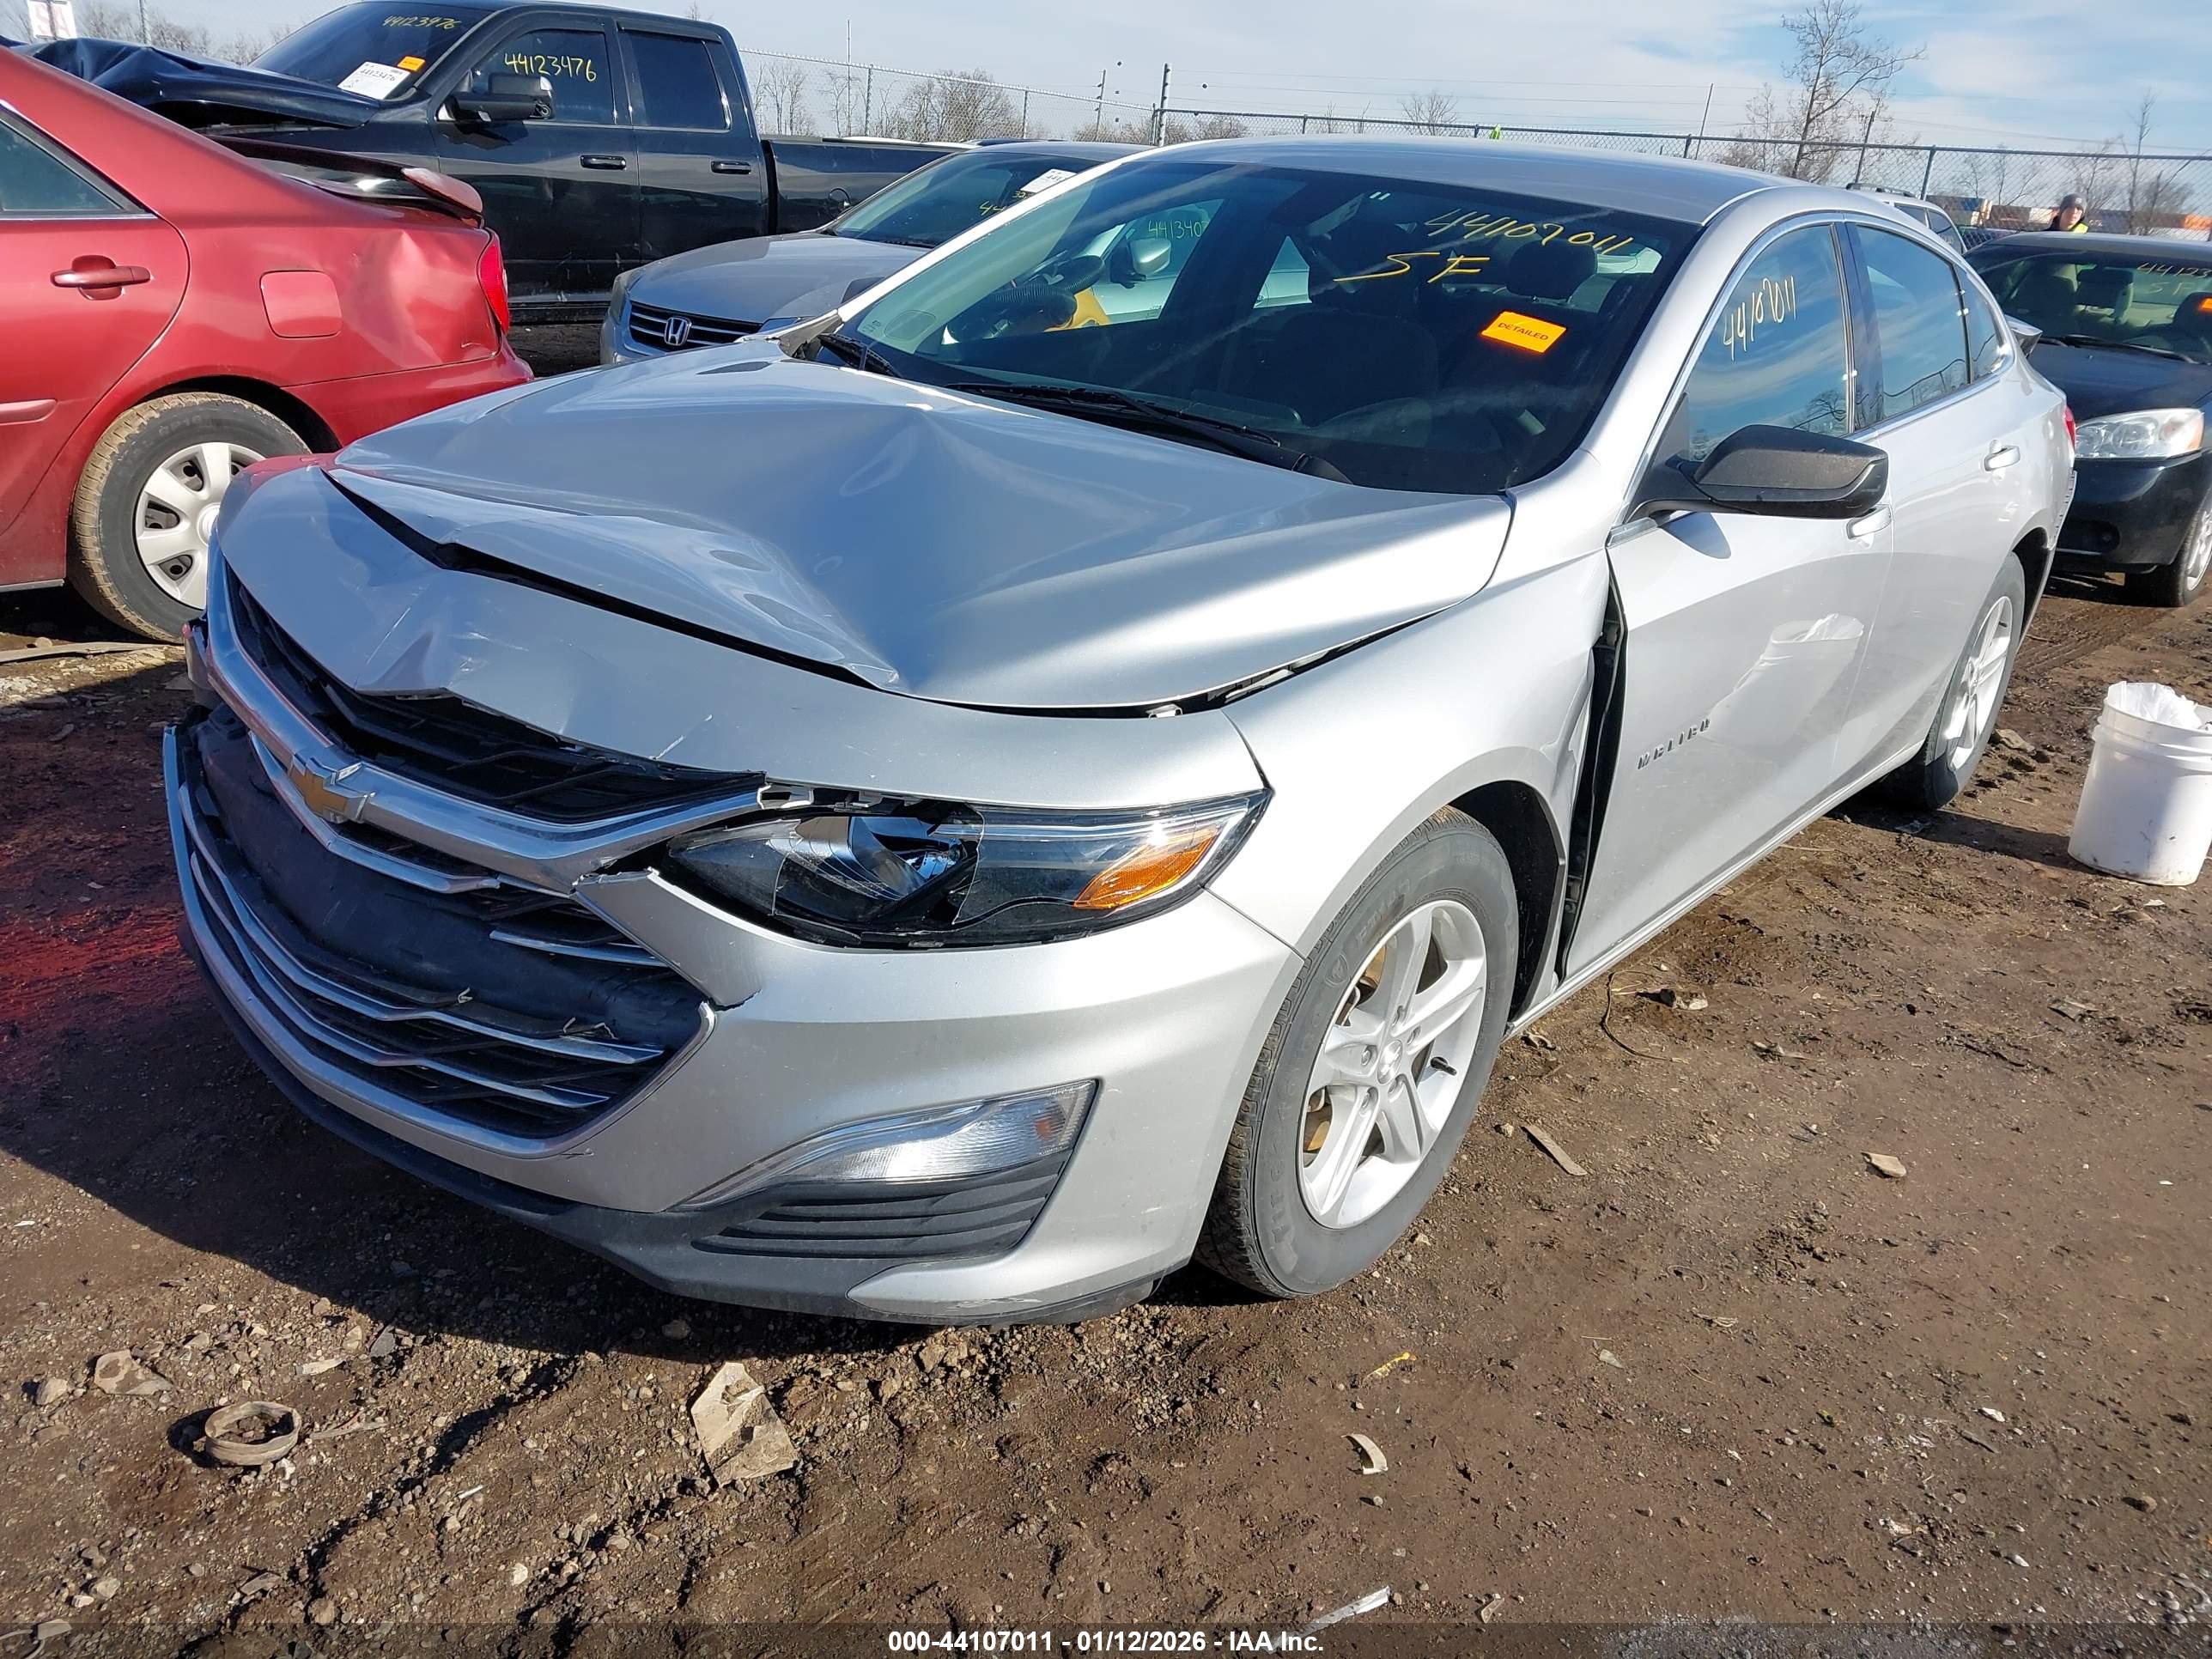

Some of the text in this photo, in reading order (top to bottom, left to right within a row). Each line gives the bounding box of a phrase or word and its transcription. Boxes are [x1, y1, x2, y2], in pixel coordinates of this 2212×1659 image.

[504, 52, 598, 82] 44123476
[1424, 208, 1634, 256] 44107011
[1498, 321, 1550, 342] DETAILED
[1723, 274, 1797, 362] 44107011
